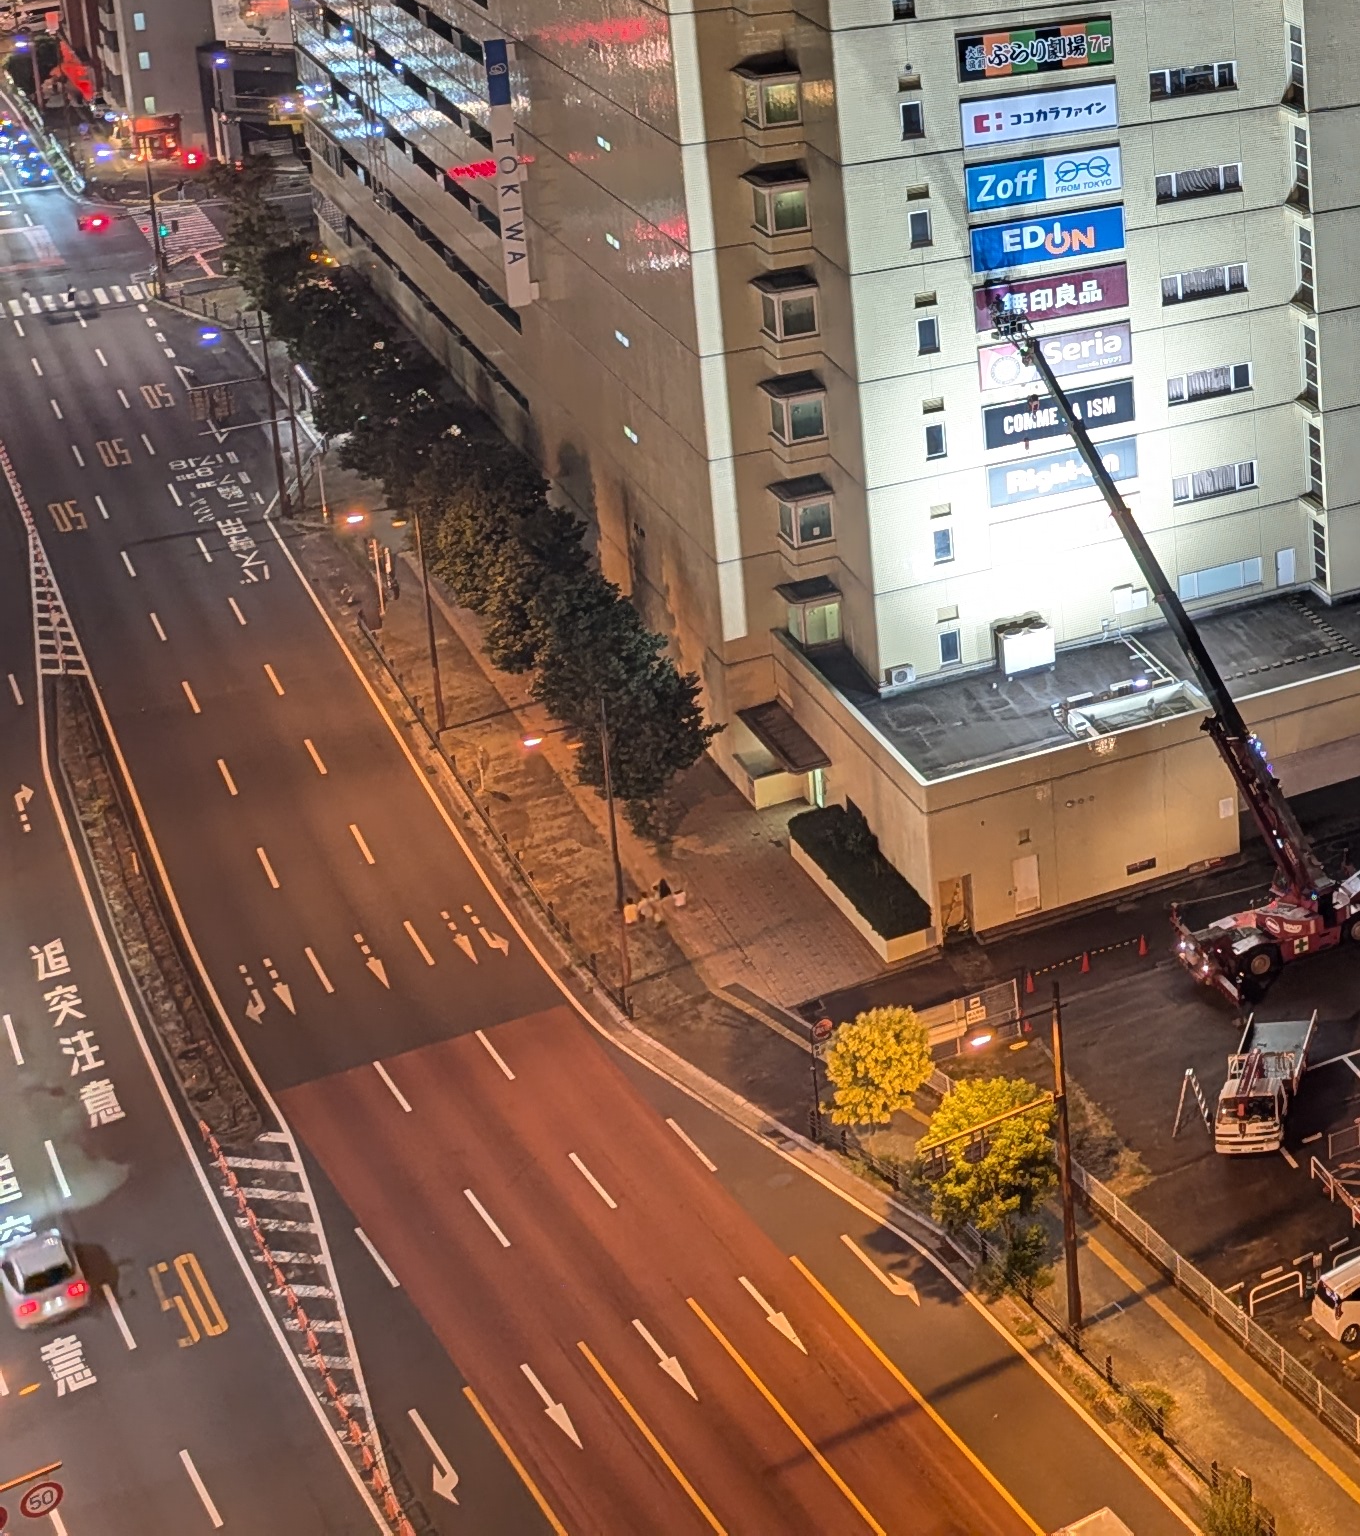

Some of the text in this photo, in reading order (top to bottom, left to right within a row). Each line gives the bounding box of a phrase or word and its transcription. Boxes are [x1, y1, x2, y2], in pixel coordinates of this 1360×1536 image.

[988, 35, 1111, 67] ぶらり劇場 7F
[1010, 102, 1107, 126] ココカラファイン
[496, 133, 526, 265] TOKIWA
[976, 168, 1038, 203] Zoff
[1055, 178, 1112, 194] FROM TOKYO
[1002, 279, 1103, 314] 無印良品
[1043, 331, 1122, 364] Seria
[139, 383, 176, 409] 50
[1003, 407, 1059, 434] COMME
[1087, 395, 1116, 419] ISM
[96, 438, 132, 467] 50
[47, 500, 89, 533] 50
[29, 937, 126, 1128] 追突注意
[148, 1252, 229, 1348] 50
[29, 1489, 55, 1511] 50
